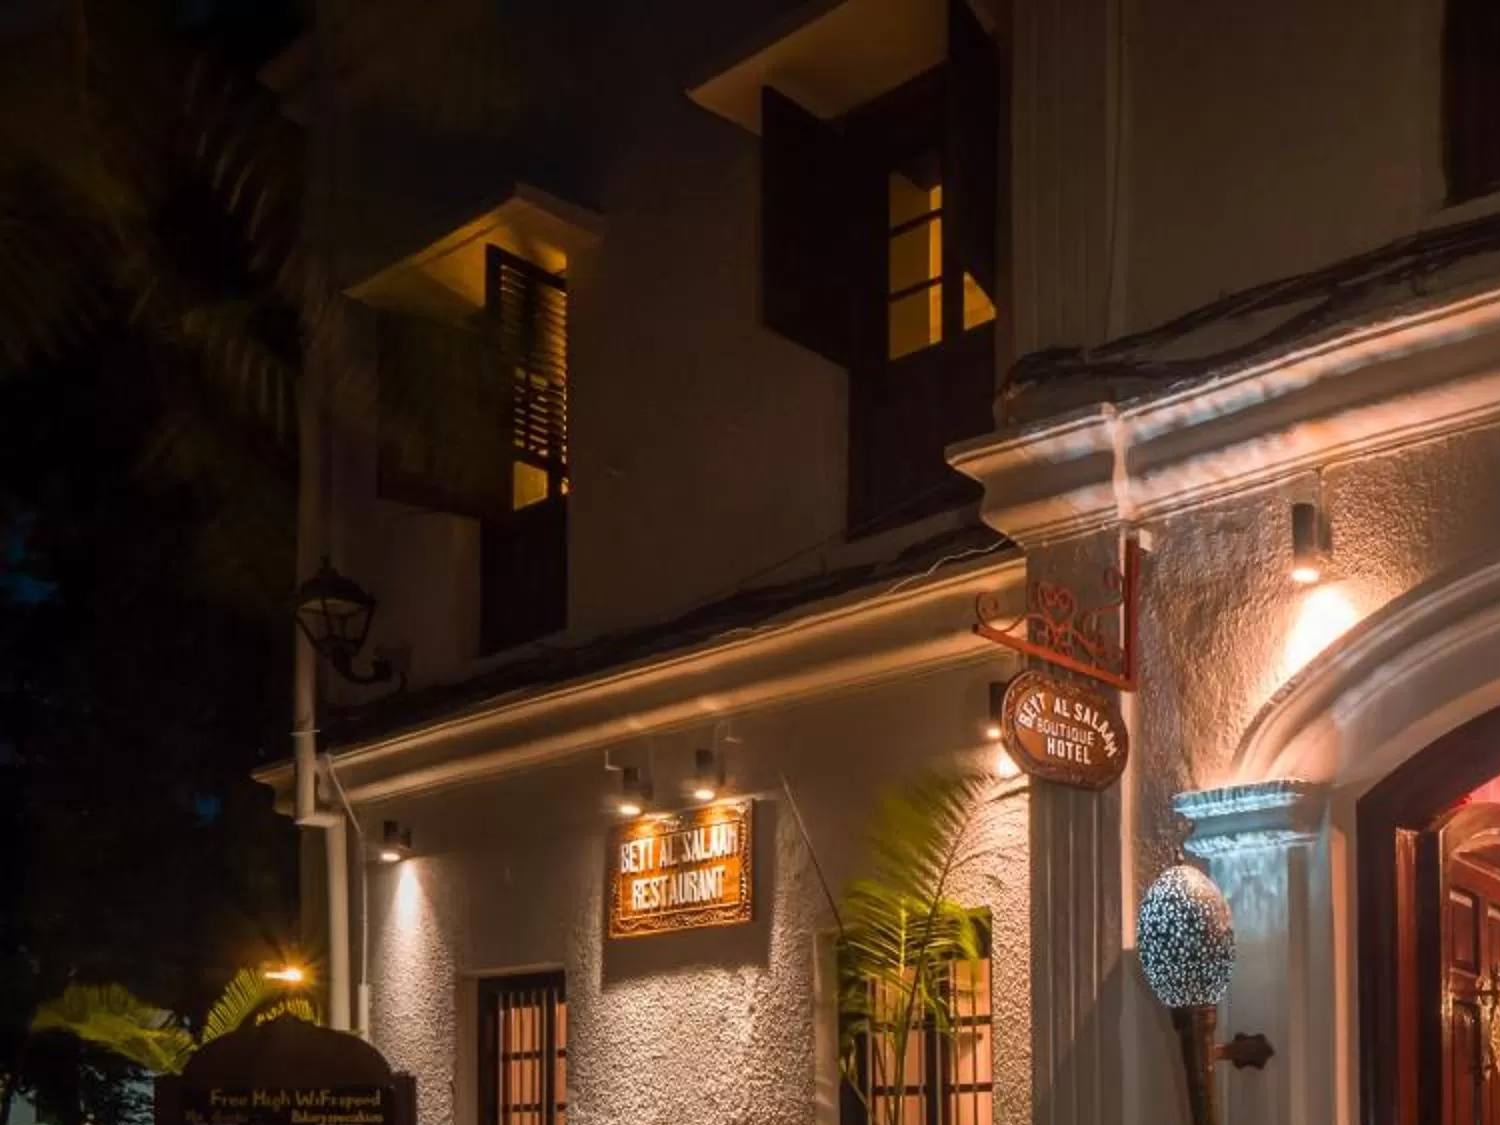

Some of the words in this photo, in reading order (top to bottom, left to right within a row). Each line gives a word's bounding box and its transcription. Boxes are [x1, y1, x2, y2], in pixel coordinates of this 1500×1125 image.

[1018, 692, 1046, 728] BEYT
[1053, 697, 1071, 719] AL
[1073, 703, 1118, 758] SALAAM
[1037, 717, 1095, 747] BOUTIQUE
[1047, 737, 1092, 765] HOTEL
[660, 835, 677, 867] AL
[632, 865, 726, 911] RESTAURANT
[210, 1088, 248, 1106] Free
